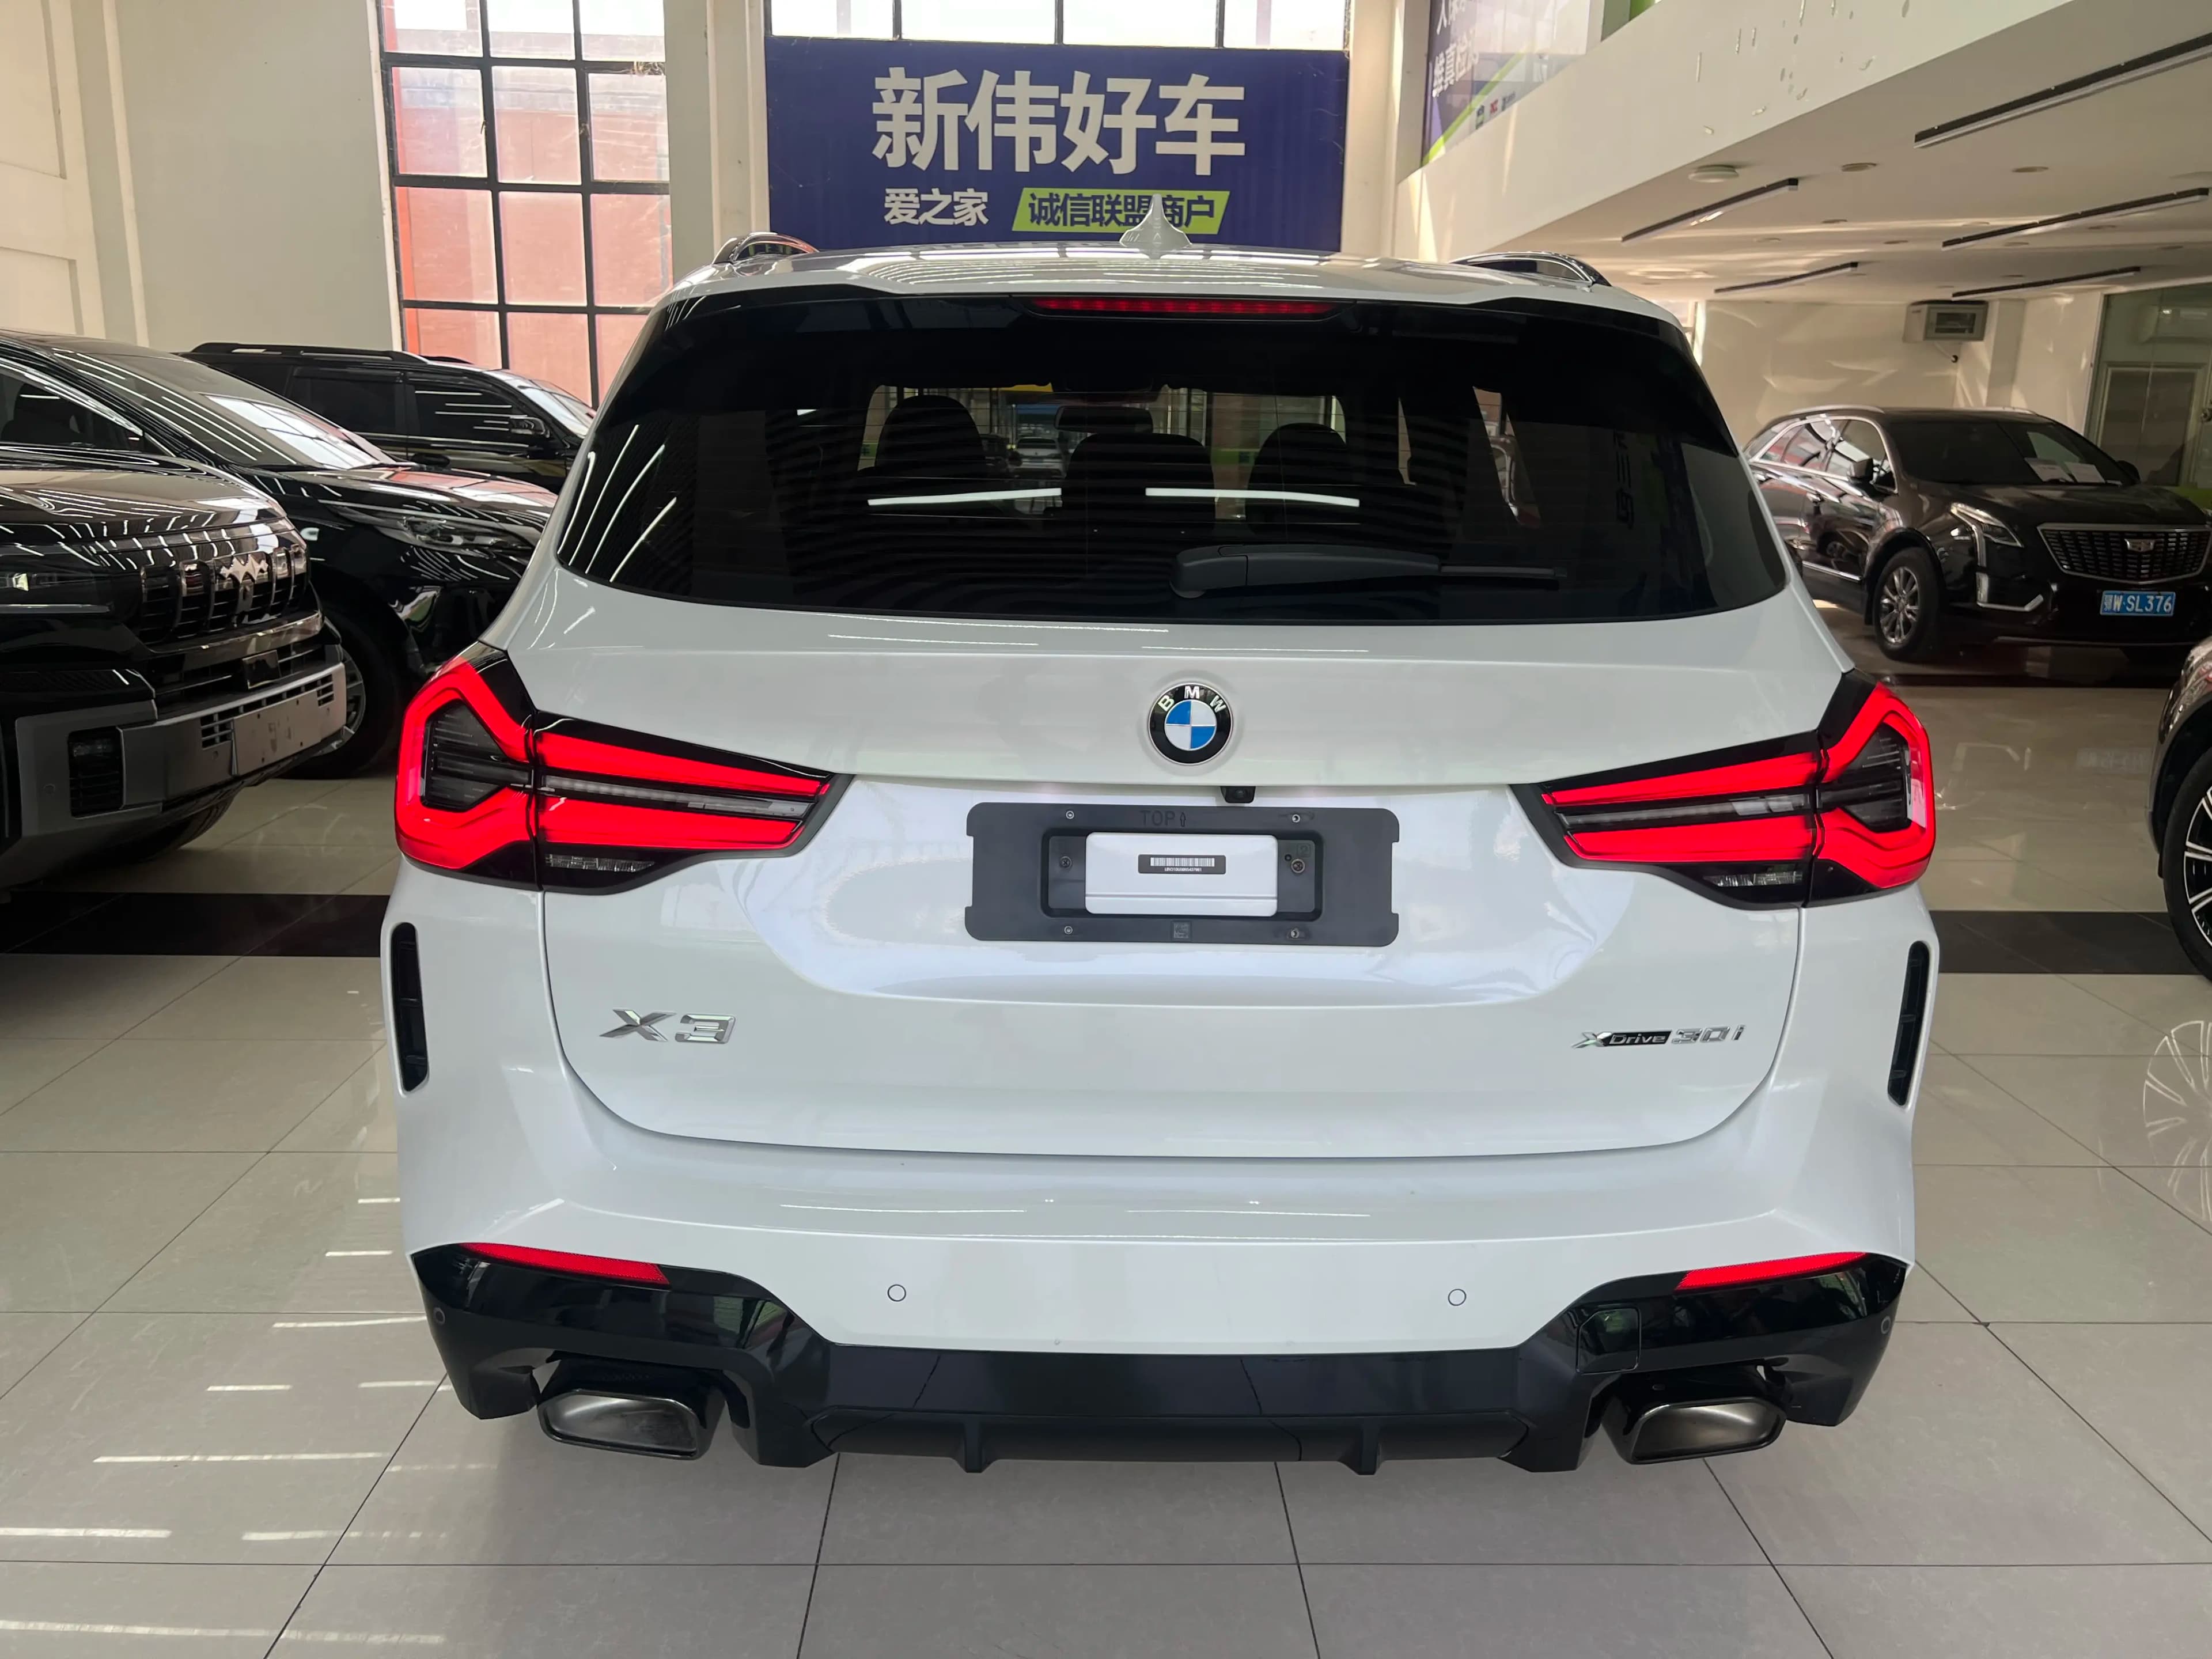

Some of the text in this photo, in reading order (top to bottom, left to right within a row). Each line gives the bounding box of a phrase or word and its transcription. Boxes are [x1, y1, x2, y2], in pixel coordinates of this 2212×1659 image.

[872, 67, 1245, 175] 新伟好车
[884, 188, 989, 226] 爱之家
[1028, 192, 1214, 228] 诚信联盟商户
[1158, 685, 1226, 713] BMW
[1140, 810, 1176, 827] TOP
[599, 1009, 736, 1044] X3
